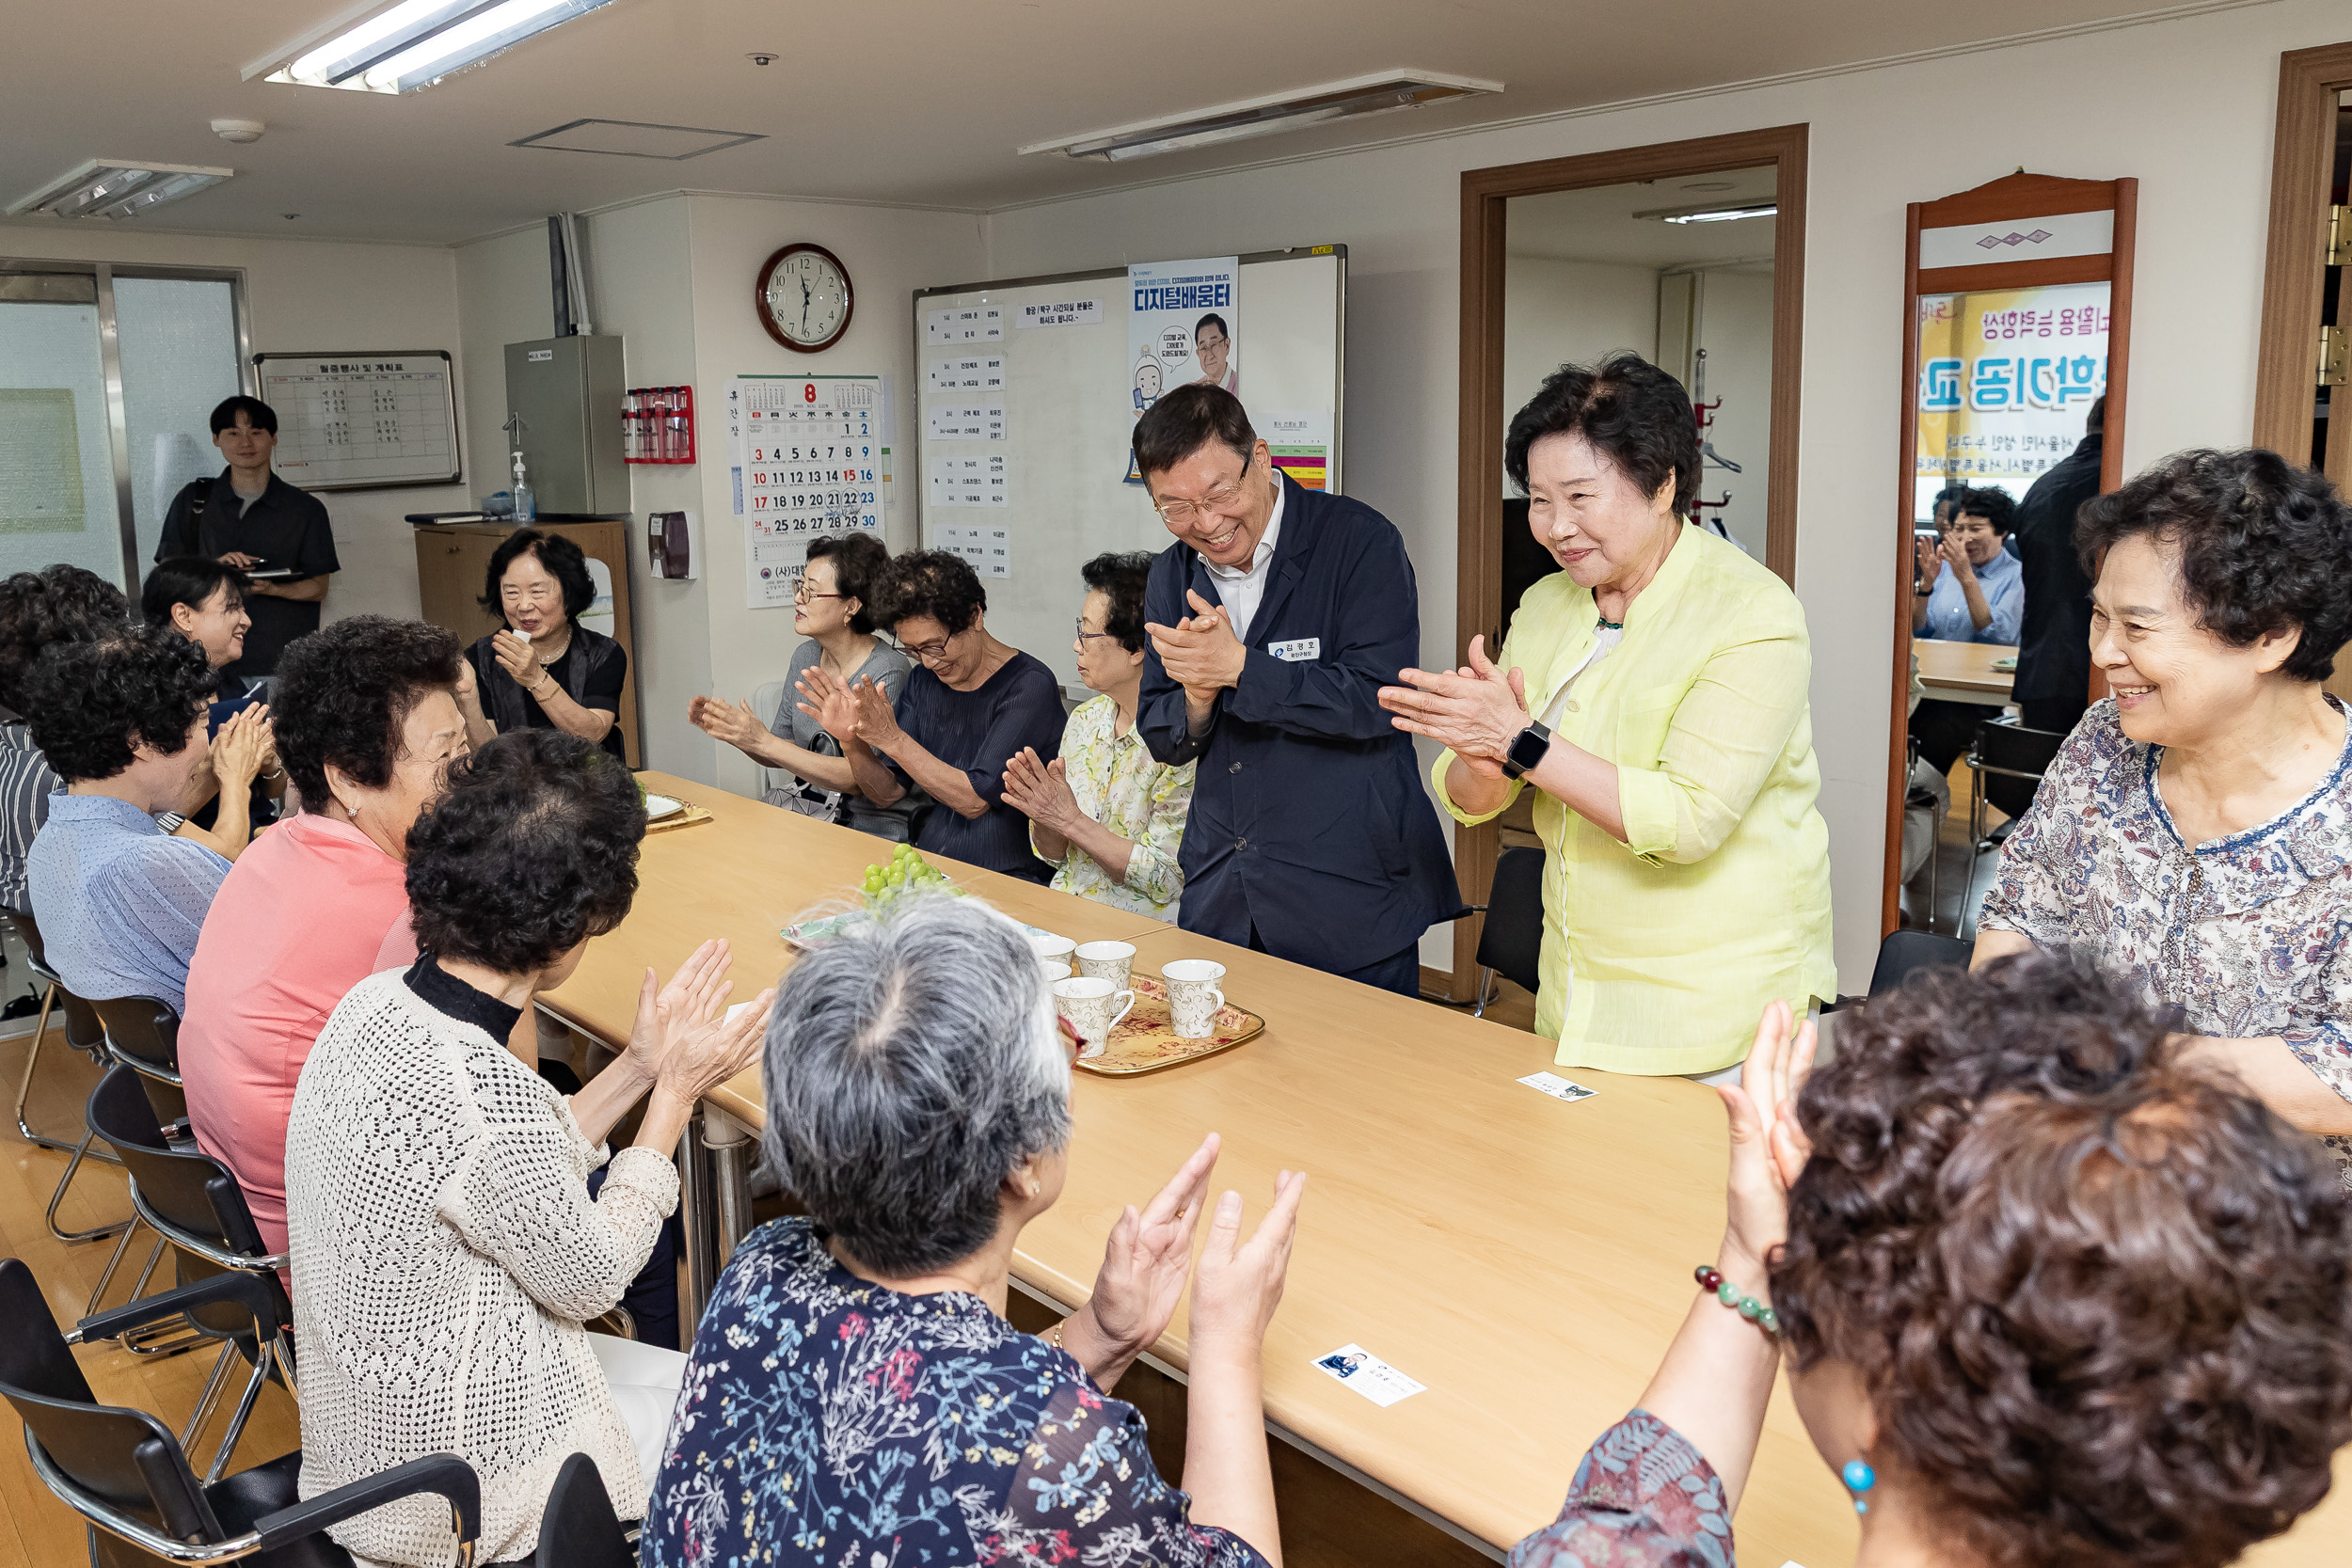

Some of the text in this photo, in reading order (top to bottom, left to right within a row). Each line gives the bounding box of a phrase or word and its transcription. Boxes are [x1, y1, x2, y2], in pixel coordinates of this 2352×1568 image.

[787, 263, 794, 274] 11
[800, 259, 810, 269] 12
[819, 264, 822, 275] 1
[776, 276, 785, 286] 10
[829, 277, 834, 287] 2
[771, 293, 778, 301] 9
[834, 293, 840, 304] 3
[1135, 284, 1230, 311] 디지털배움터
[1053, 303, 1073, 312] 시간되실
[1077, 301, 1093, 310] 분들은
[778, 309, 784, 321] 8
[829, 310, 834, 320] 4
[789, 323, 794, 333] 7
[804, 327, 810, 338] 6
[818, 324, 824, 333] 5
[363, 364, 372, 372] 및
[375, 363, 404, 372] 계획표
[804, 384, 817, 403] 8
[845, 423, 868, 435] 1 2
[755, 446, 868, 460] 3 4 5 6 7 8 9
[754, 469, 873, 484] 10 11 12 13 14 15 16
[755, 493, 874, 508] 17 18 19 20 21 22 23
[774, 520, 788, 531] 25
[793, 519, 806, 530] 26
[811, 518, 824, 529] 27
[828, 516, 841, 528] 28
[845, 515, 858, 527] 29
[862, 515, 876, 526] 30
